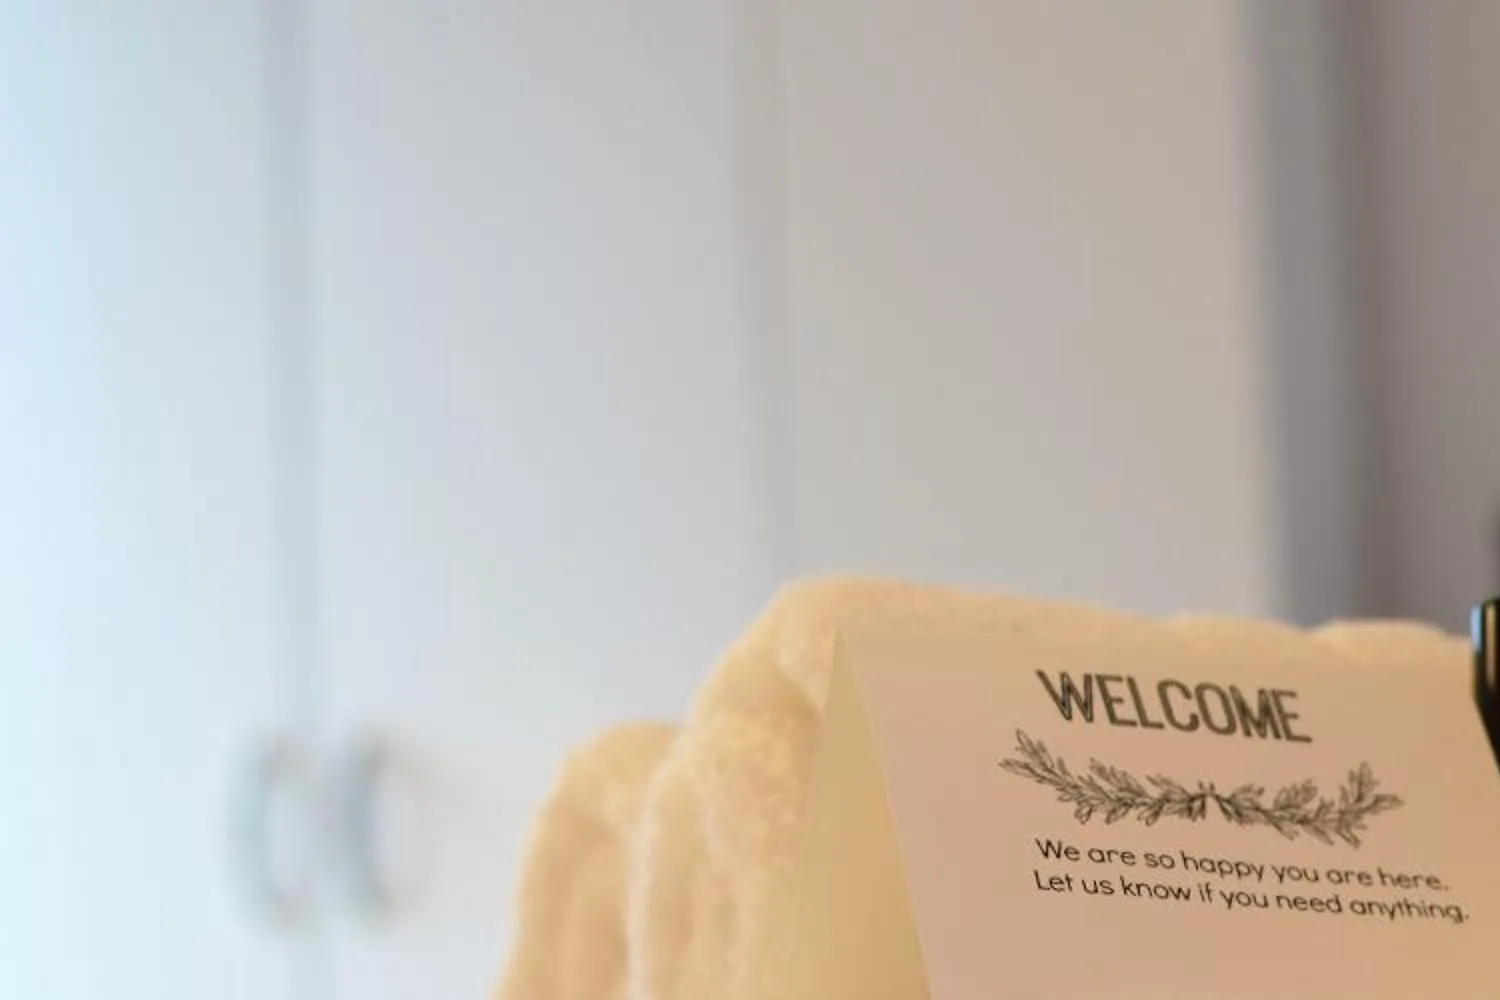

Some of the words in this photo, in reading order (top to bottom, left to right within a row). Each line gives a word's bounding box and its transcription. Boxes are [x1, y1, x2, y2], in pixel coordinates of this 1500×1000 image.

[1035, 669, 1313, 743] WELCOME
[1035, 837, 1081, 861] We
[1087, 847, 1136, 866] are
[1143, 852, 1176, 869] so
[1180, 849, 1264, 883] happy
[1270, 862, 1319, 884] you
[1325, 868, 1374, 887] are
[1377, 866, 1449, 891] here.
[1034, 869, 1073, 893] Let
[1081, 879, 1115, 895] us
[1119, 875, 1191, 901] know
[1197, 882, 1214, 903] if
[1219, 889, 1269, 910] you
[1275, 894, 1343, 914] need
[1350, 898, 1469, 924] anything.
